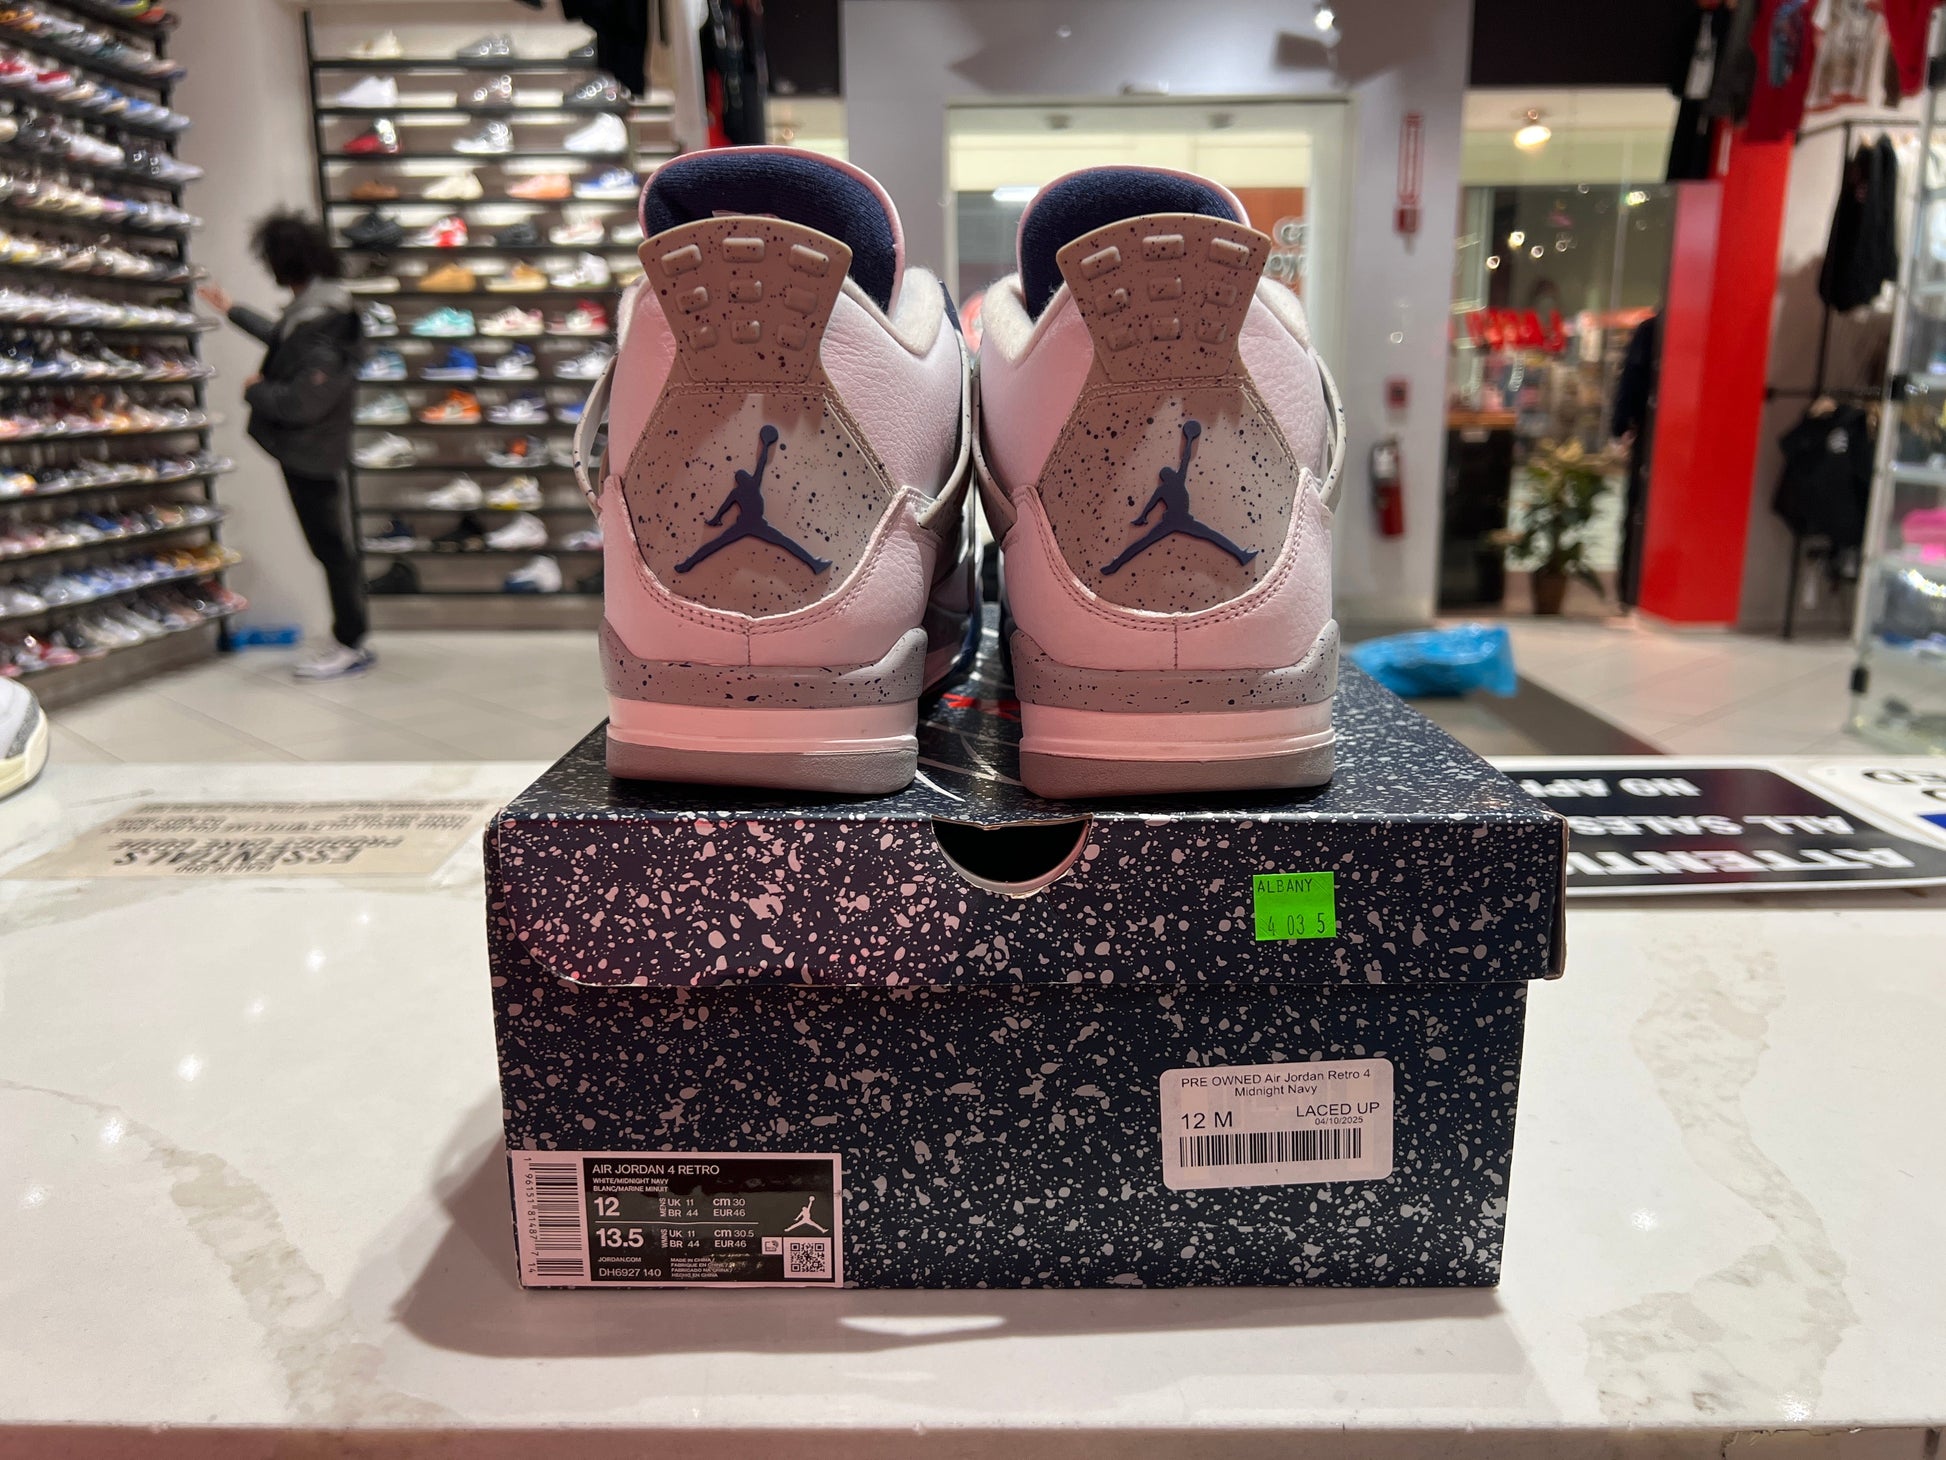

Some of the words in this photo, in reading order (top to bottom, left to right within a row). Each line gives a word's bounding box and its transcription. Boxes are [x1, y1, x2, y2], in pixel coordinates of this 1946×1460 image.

[1618, 777, 1701, 797] NO
[1567, 815, 1744, 836] SALES
[1741, 815, 1855, 835] ALL
[113, 846, 362, 866] ESSENTIALS
[1258, 878, 1312, 893] ALBANY
[1181, 1077, 1208, 1088] PRE
[1211, 1074, 1262, 1087] OWNED
[1264, 1073, 1281, 1083] Air
[1284, 1071, 1324, 1083] Jordan
[1328, 1070, 1360, 1080] Retro
[1363, 1069, 1370, 1078] 4
[1234, 1085, 1285, 1098] Midnight
[1287, 1084, 1318, 1095] Navy
[1296, 1103, 1352, 1118] LACED
[1357, 1101, 1380, 1115] UP
[1181, 1112, 1206, 1130] 12
[1214, 1110, 1233, 1128] M
[1314, 1115, 1364, 1126] 04/10/2025
[592, 1164, 613, 1174] AIR
[615, 1164, 665, 1175] JORDAN
[667, 1165, 675, 1175] 4
[678, 1165, 720, 1176] RETRO
[525, 1173, 535, 1204] 96151
[593, 1177, 649, 1185] WHITE/MIDNIGHT
[593, 1185, 644, 1193] BLANC/MARINE
[594, 1196, 621, 1217] 12
[659, 1197, 667, 1217] MENS
[667, 1198, 681, 1207] UK
[686, 1198, 695, 1206] 11
[713, 1197, 731, 1206] cm
[733, 1198, 746, 1206] 30
[668, 1208, 682, 1217] BR
[686, 1209, 699, 1217] 44
[527, 1210, 538, 1241] 81487
[596, 1227, 645, 1248] 13.5
[669, 1230, 683, 1238] UK
[687, 1230, 696, 1238] 11
[714, 1229, 732, 1238] cm
[734, 1230, 755, 1238] 30.5
[669, 1239, 684, 1248] BR
[687, 1240, 700, 1248] 44
[599, 1267, 640, 1277] DH6927
[643, 1268, 662, 1277] 140
